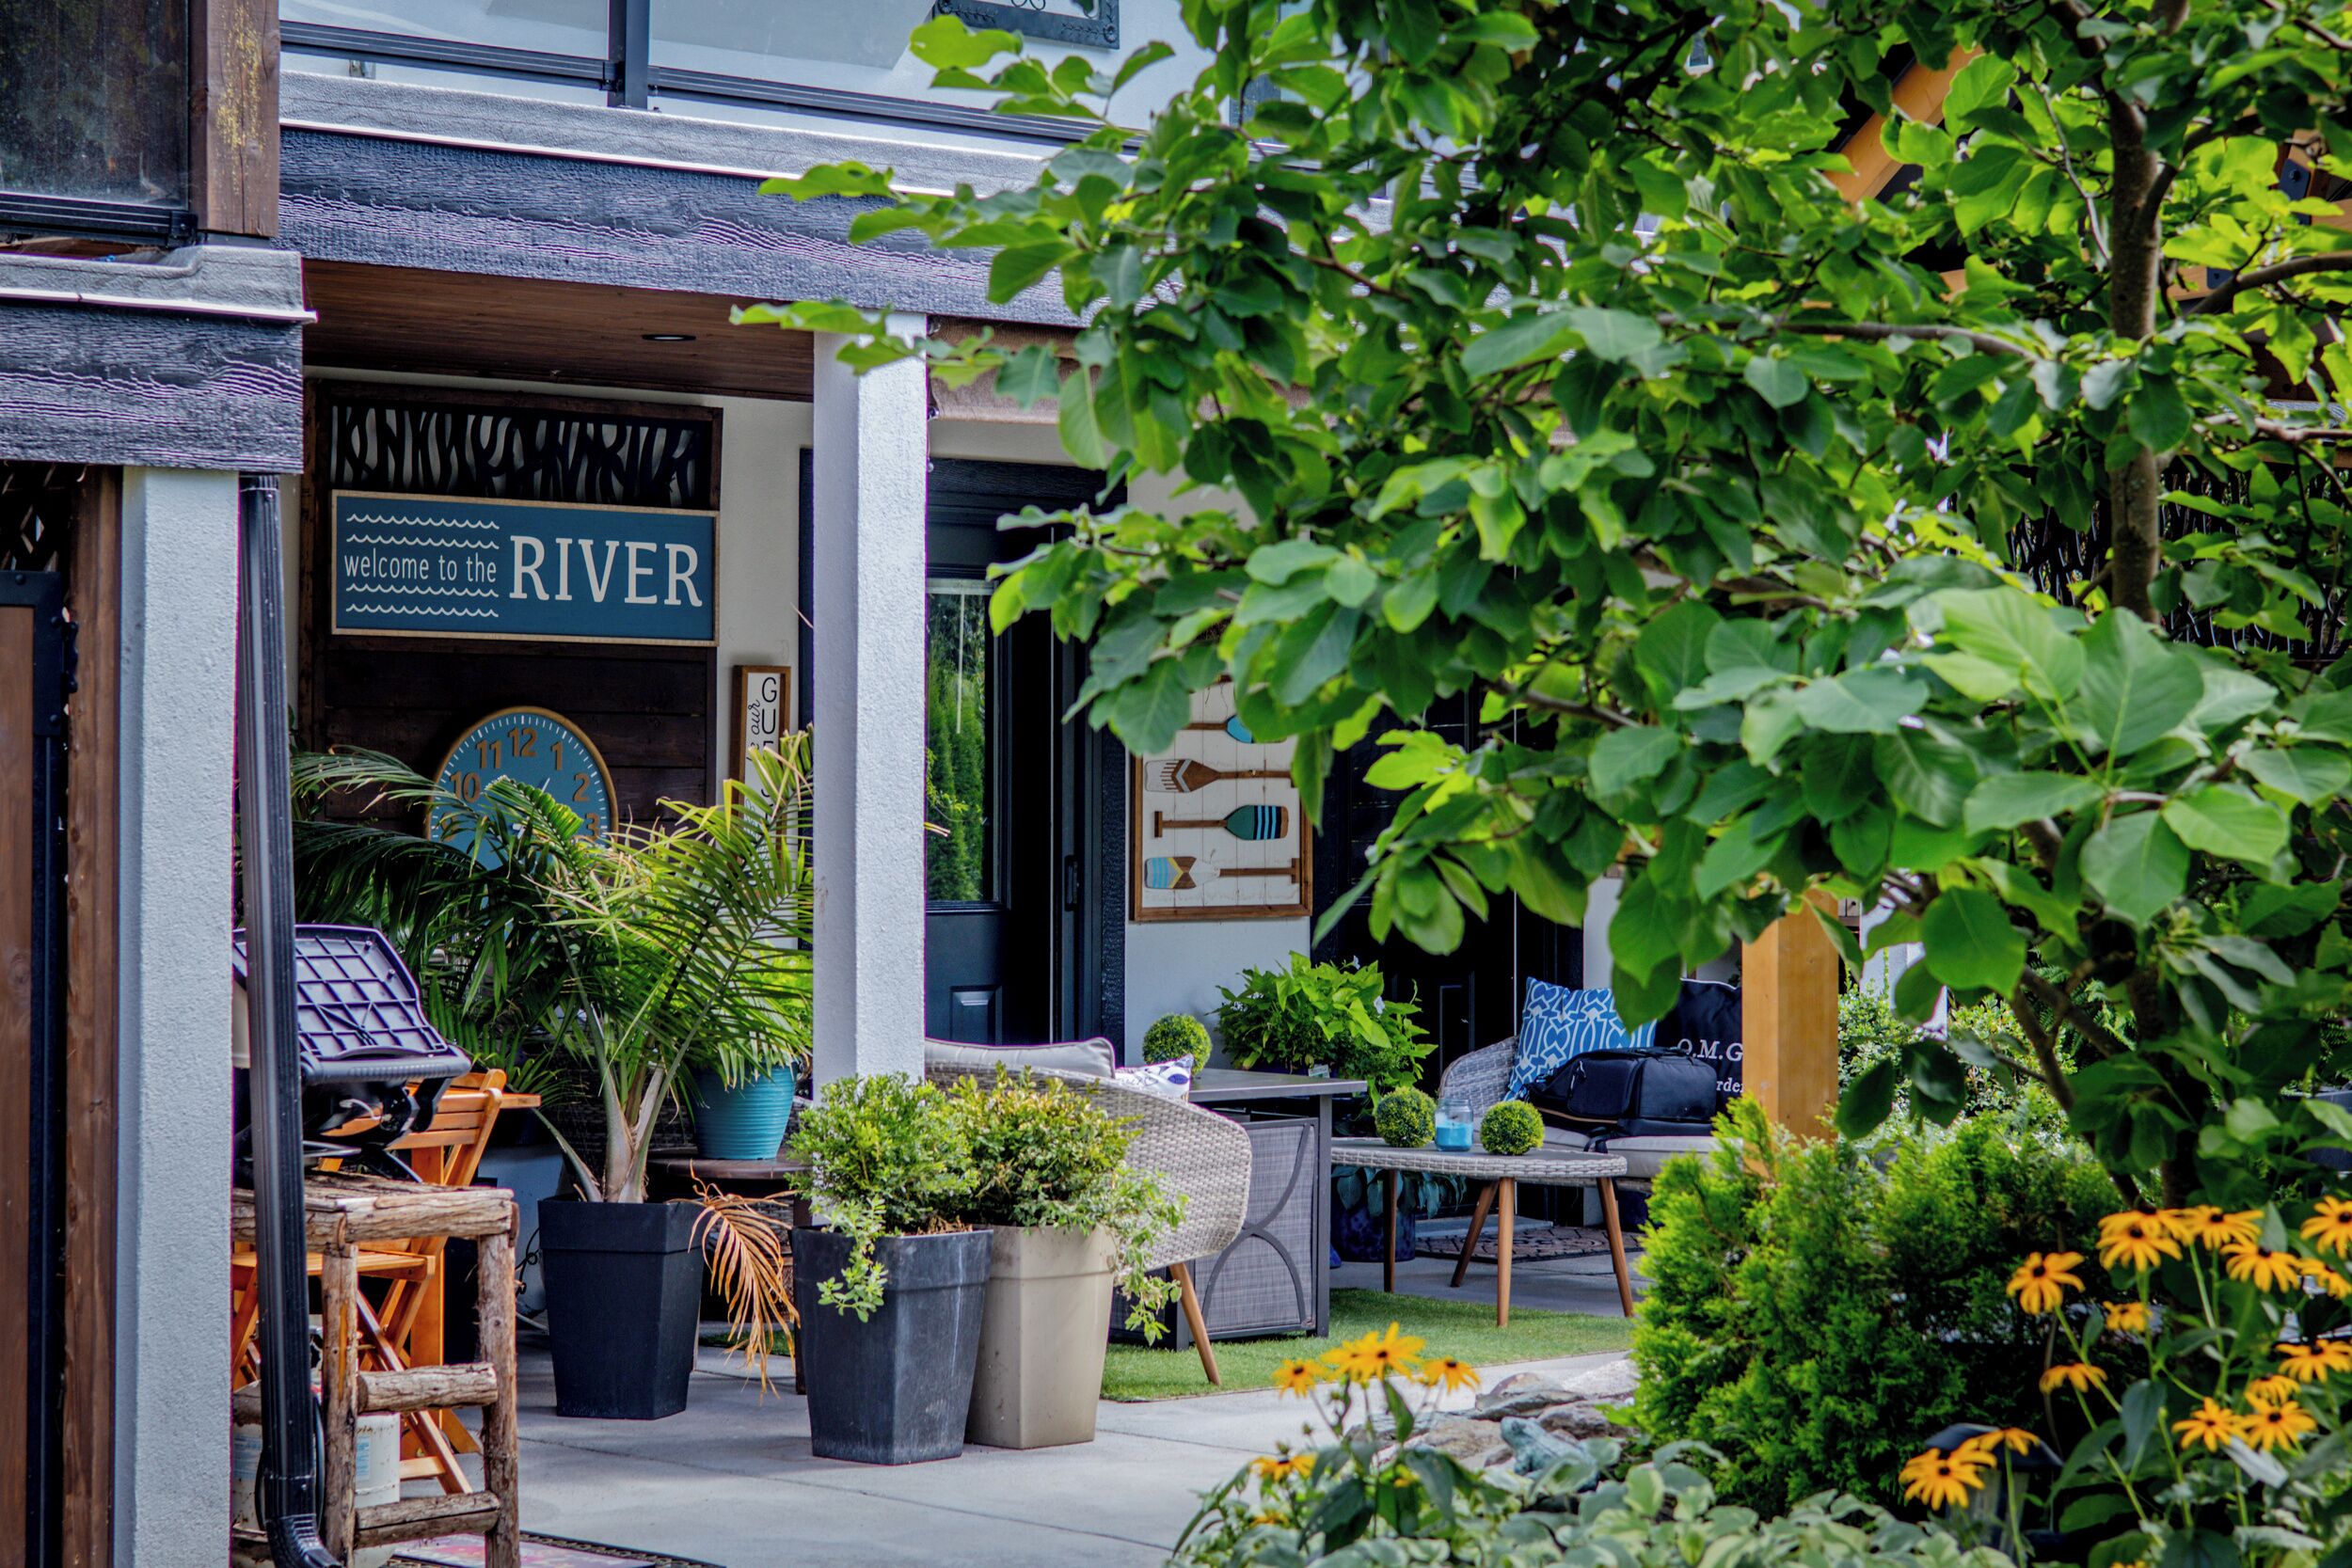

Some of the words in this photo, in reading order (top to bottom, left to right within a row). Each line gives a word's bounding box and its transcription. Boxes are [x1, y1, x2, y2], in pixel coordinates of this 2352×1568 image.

[344, 547, 429, 580] welcome
[438, 554, 457, 581] to
[467, 552, 497, 583] the
[509, 535, 703, 608] RIVER
[477, 739, 501, 769] 11
[508, 727, 537, 757] 12
[550, 741, 563, 770] 1
[450, 771, 481, 803] 10
[572, 773, 590, 801] 2
[585, 813, 599, 840] 3
